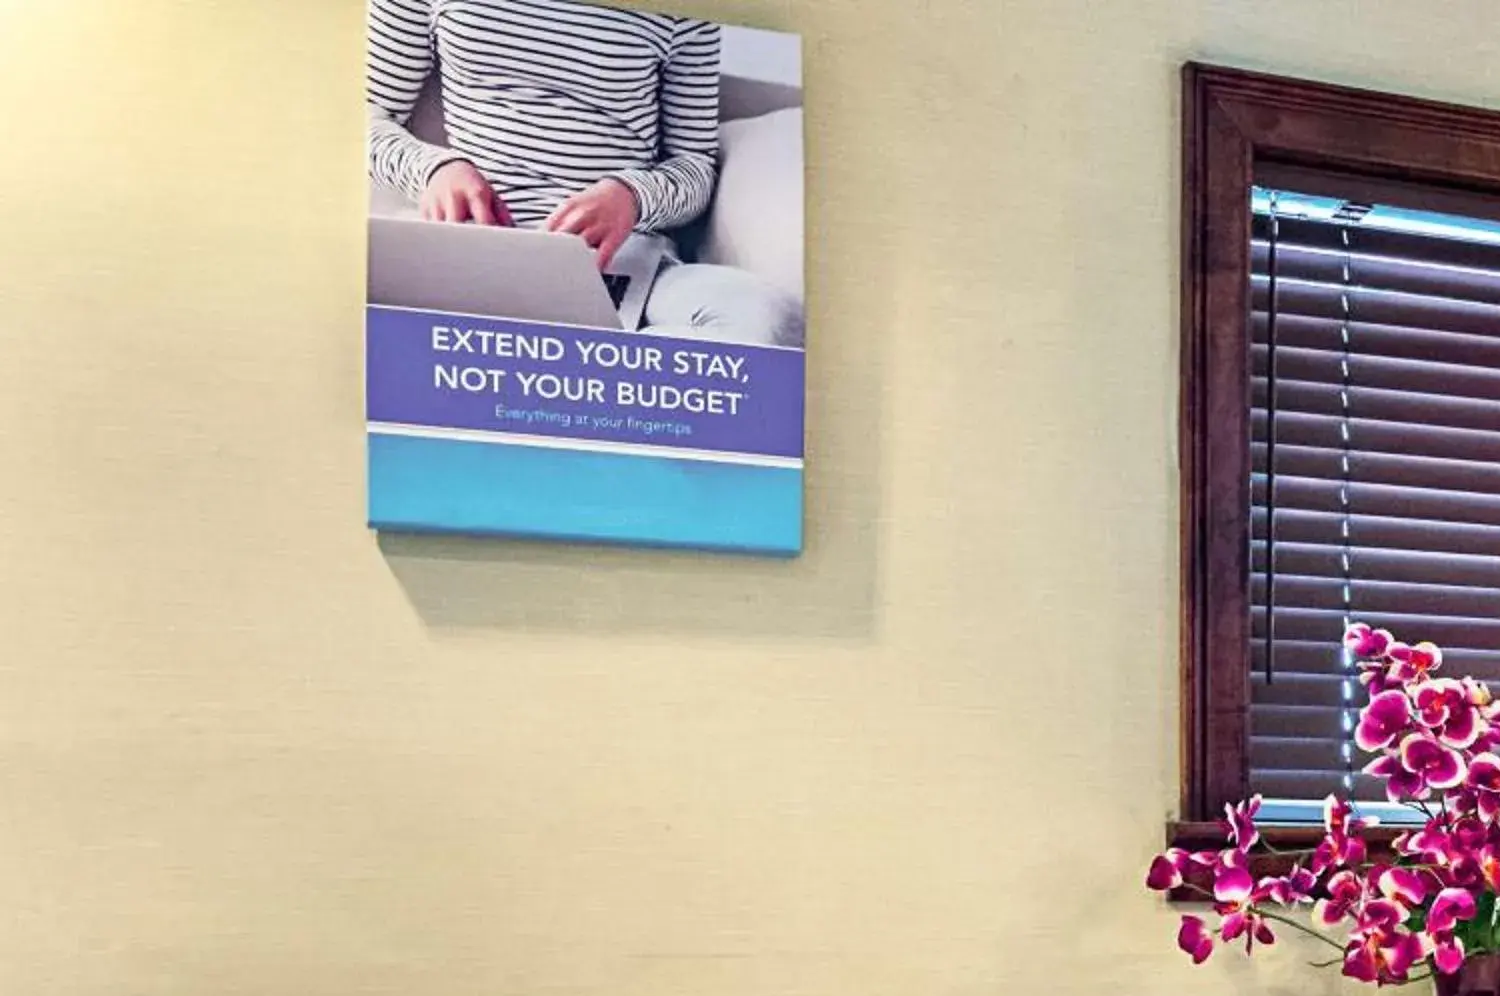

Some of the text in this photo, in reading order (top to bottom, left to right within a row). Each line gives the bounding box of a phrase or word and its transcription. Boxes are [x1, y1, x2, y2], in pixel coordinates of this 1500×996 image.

[432, 326, 749, 383] EXTEND YOUR STAY,
[434, 365, 506, 393] NOT
[516, 372, 605, 403] YOUR
[495, 404, 692, 436] Everything at your fingertips
